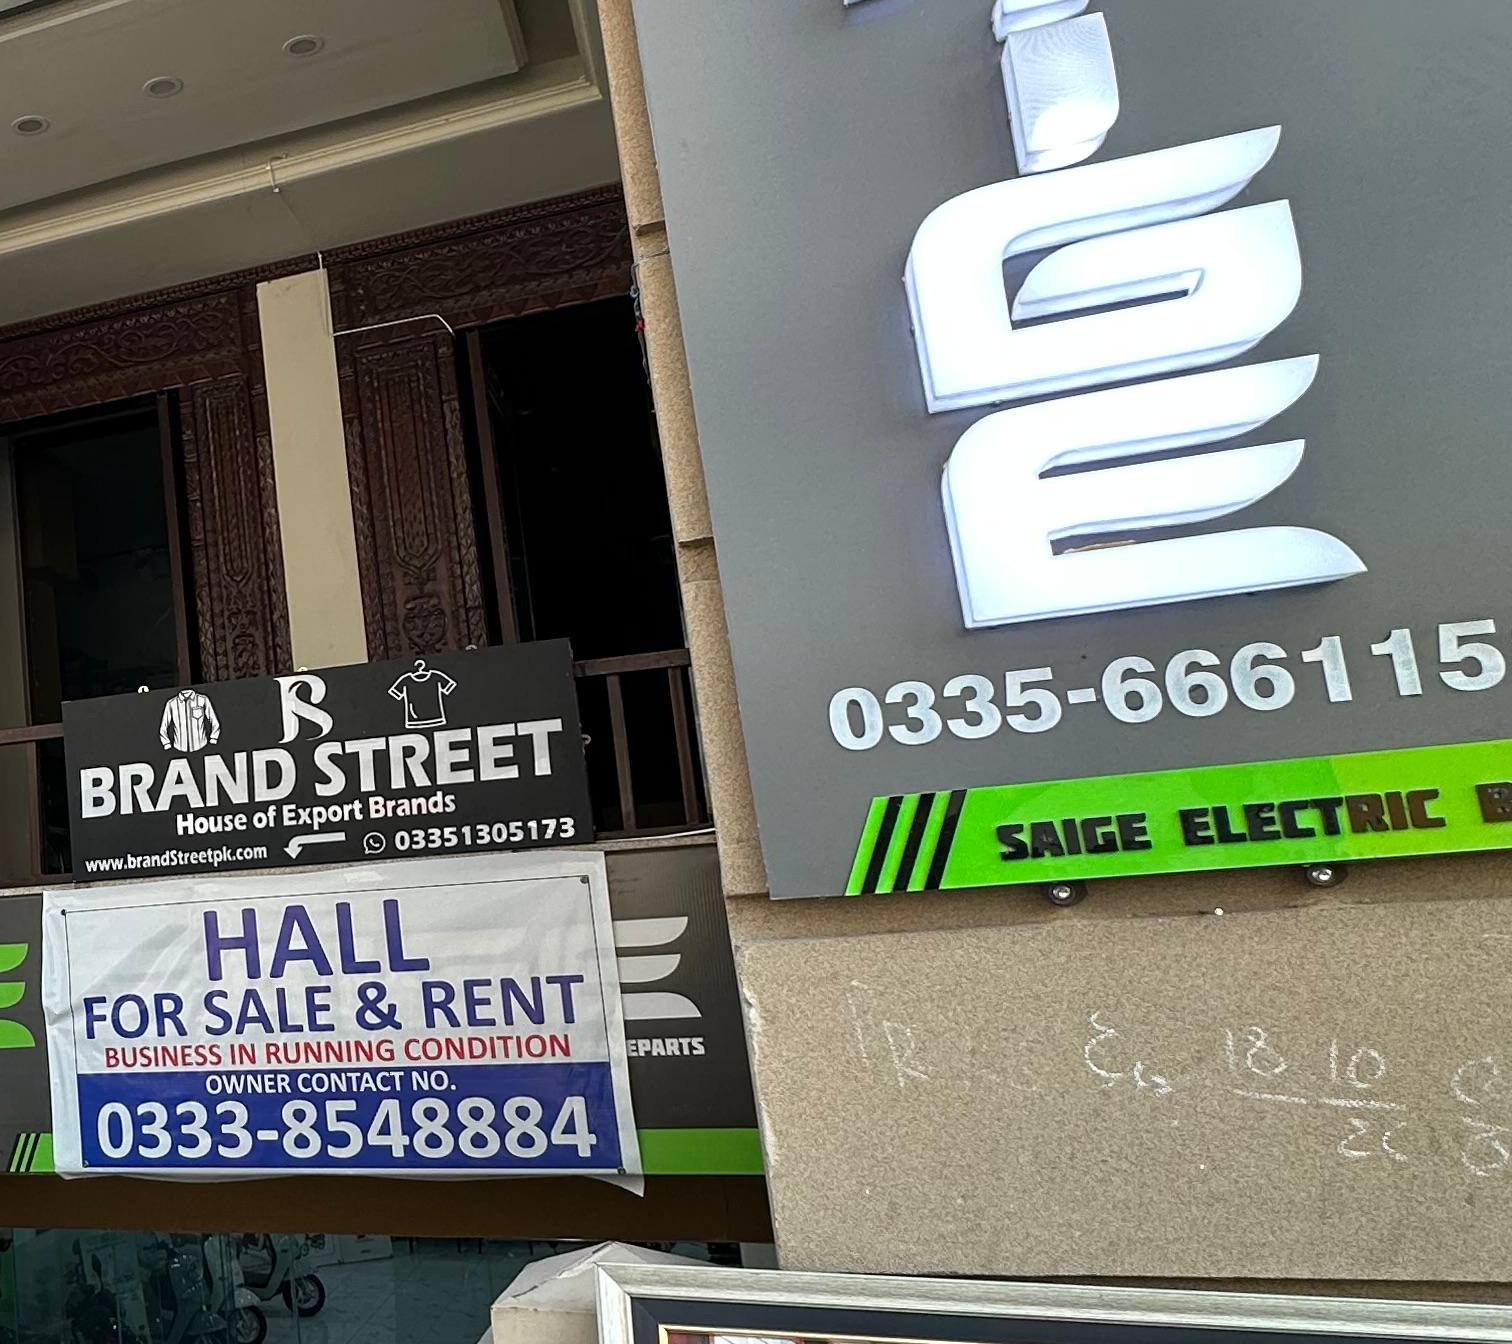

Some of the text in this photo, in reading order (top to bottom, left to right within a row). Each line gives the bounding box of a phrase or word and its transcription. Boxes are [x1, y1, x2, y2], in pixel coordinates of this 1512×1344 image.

[828, 618, 1508, 751] 0335-666115
[80, 717, 564, 820] BRAND STREET
[176, 790, 456, 837] House of Export Brands
[394, 816, 576, 851] 03351305173
[997, 812, 1153, 862] SAIGE
[1179, 788, 1448, 847] ELECTRIC
[85, 843, 268, 872] www.brandStreetpk.com
[201, 897, 431, 981] HALL
[85, 974, 585, 1041] FOR SALE & RENT
[104, 1033, 571, 1069] BUSINESS IN RUNNING CONDITION
[205, 1067, 457, 1095] OWNER CONTACT NO.
[97, 1095, 597, 1160] 0333-8548884
